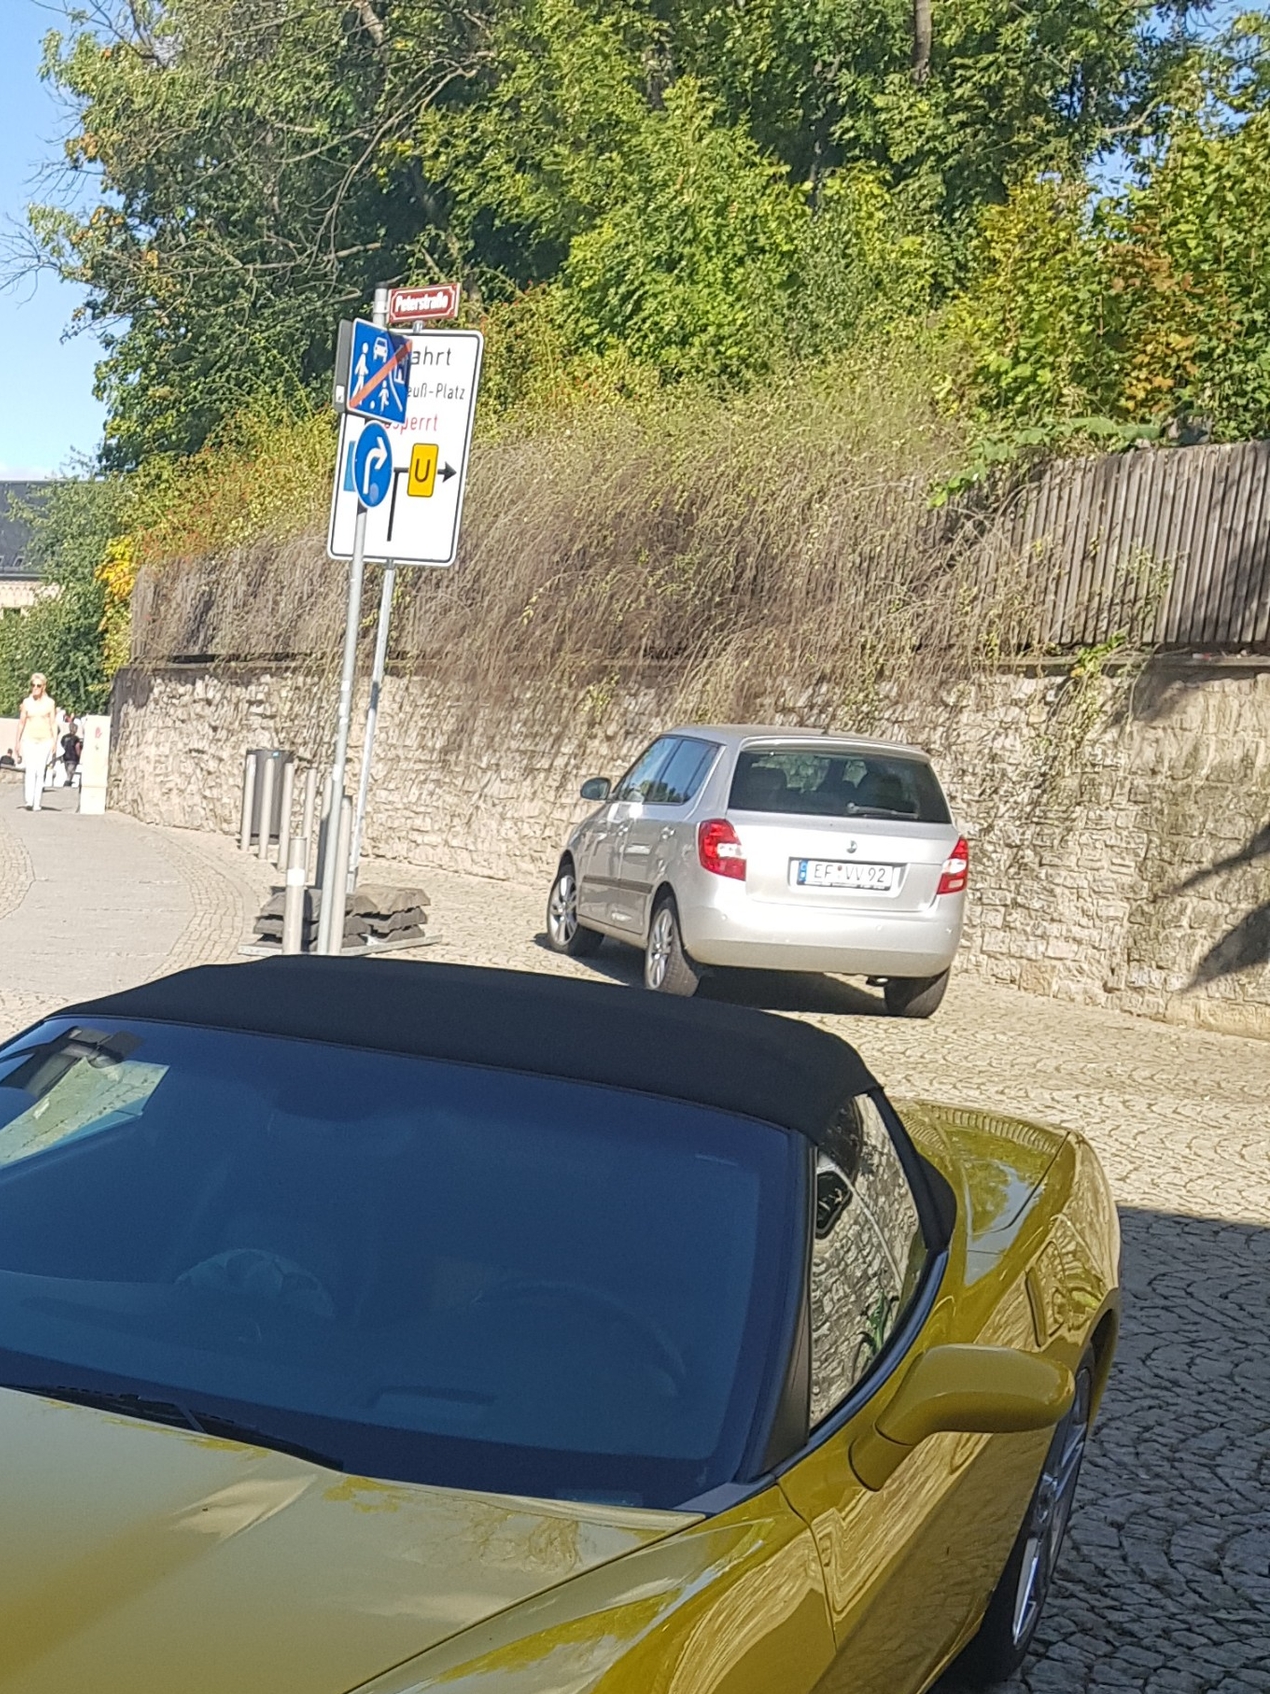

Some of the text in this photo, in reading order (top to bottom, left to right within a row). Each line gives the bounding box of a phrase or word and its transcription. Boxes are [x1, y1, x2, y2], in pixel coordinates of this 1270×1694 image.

[394, 291, 449, 312] Peterstraße
[410, 345, 452, 366] ahrt
[407, 382, 466, 400] euß-Platz
[384, 414, 438, 436] perrt
[414, 459, 431, 483] U
[814, 863, 886, 883] EF VV 92
